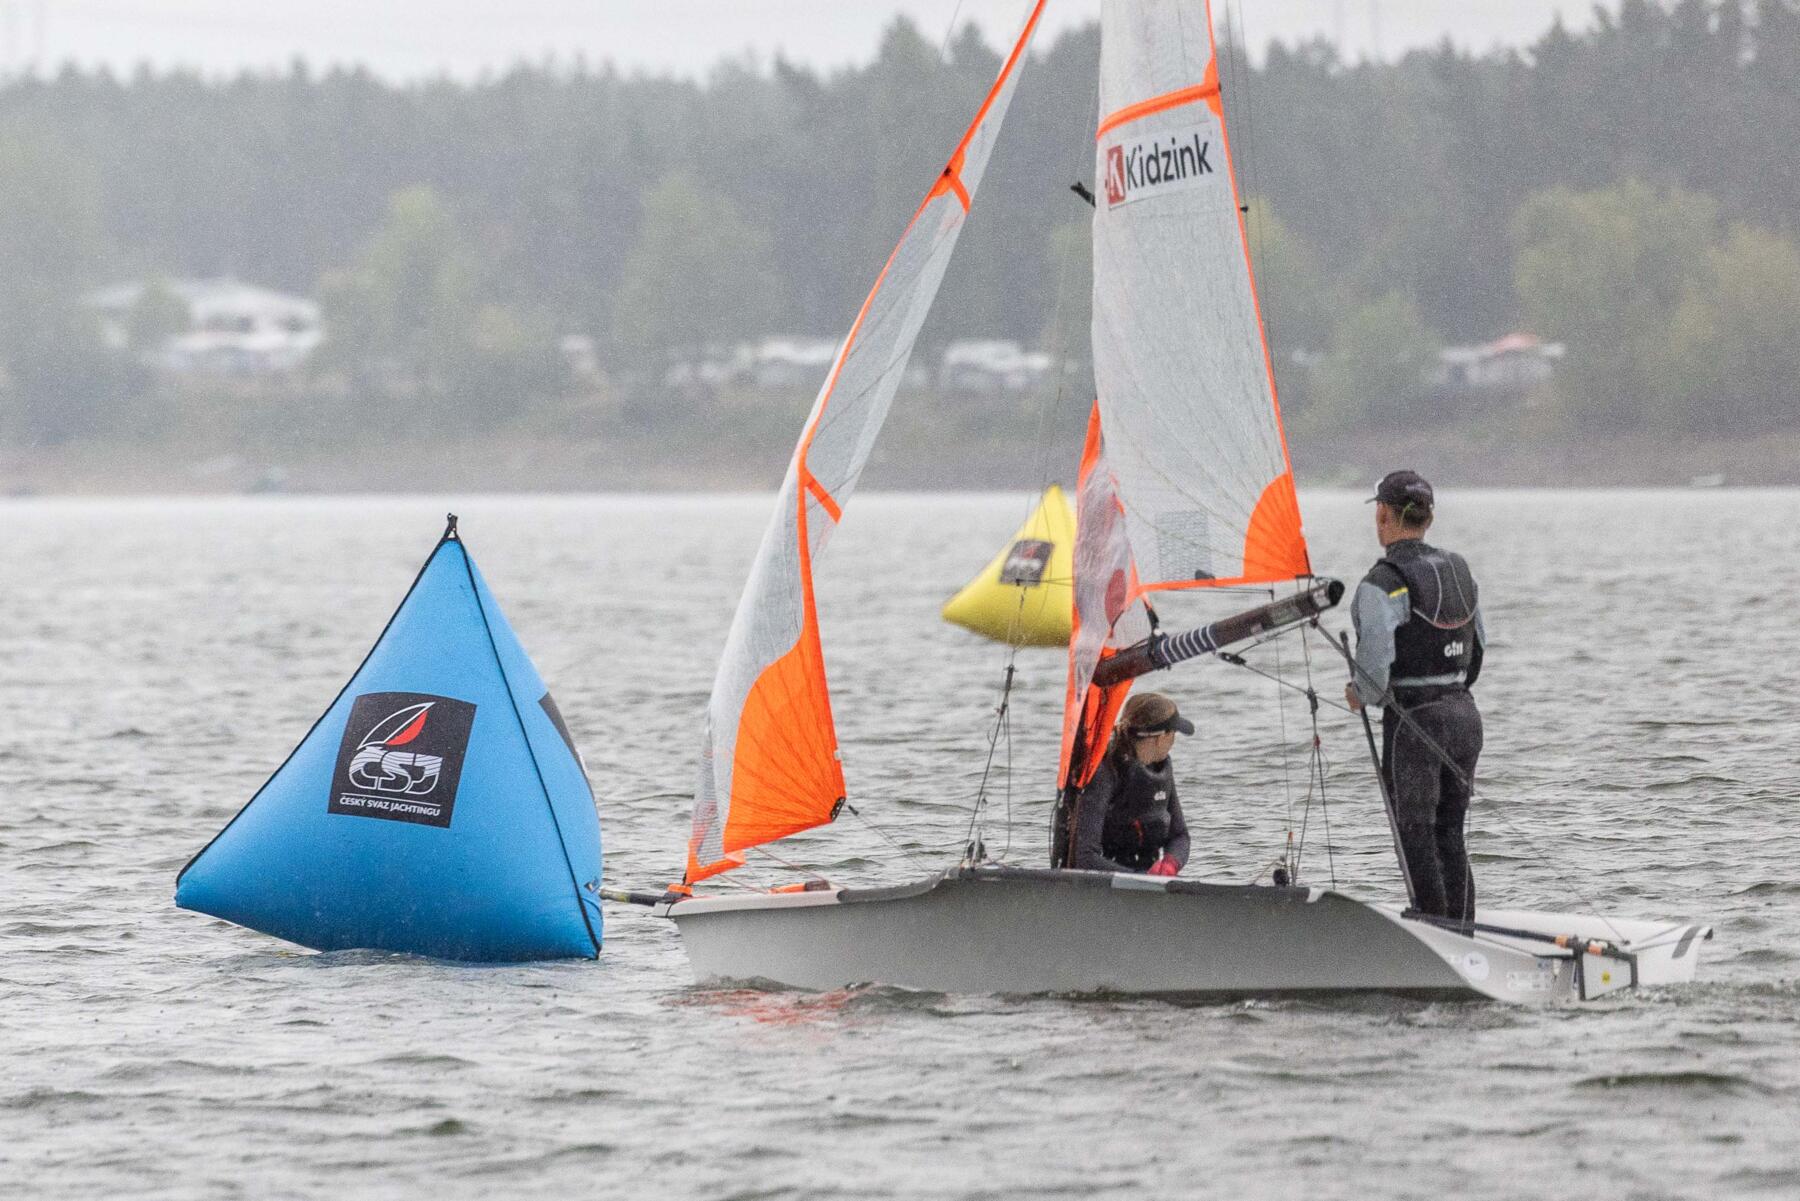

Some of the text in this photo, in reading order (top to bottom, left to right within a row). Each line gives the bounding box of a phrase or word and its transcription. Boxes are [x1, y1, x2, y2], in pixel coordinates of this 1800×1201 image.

[1125, 133, 1213, 191] Kidzink
[339, 796, 441, 817] ČESKÝ SVAZ JACHTINGU
